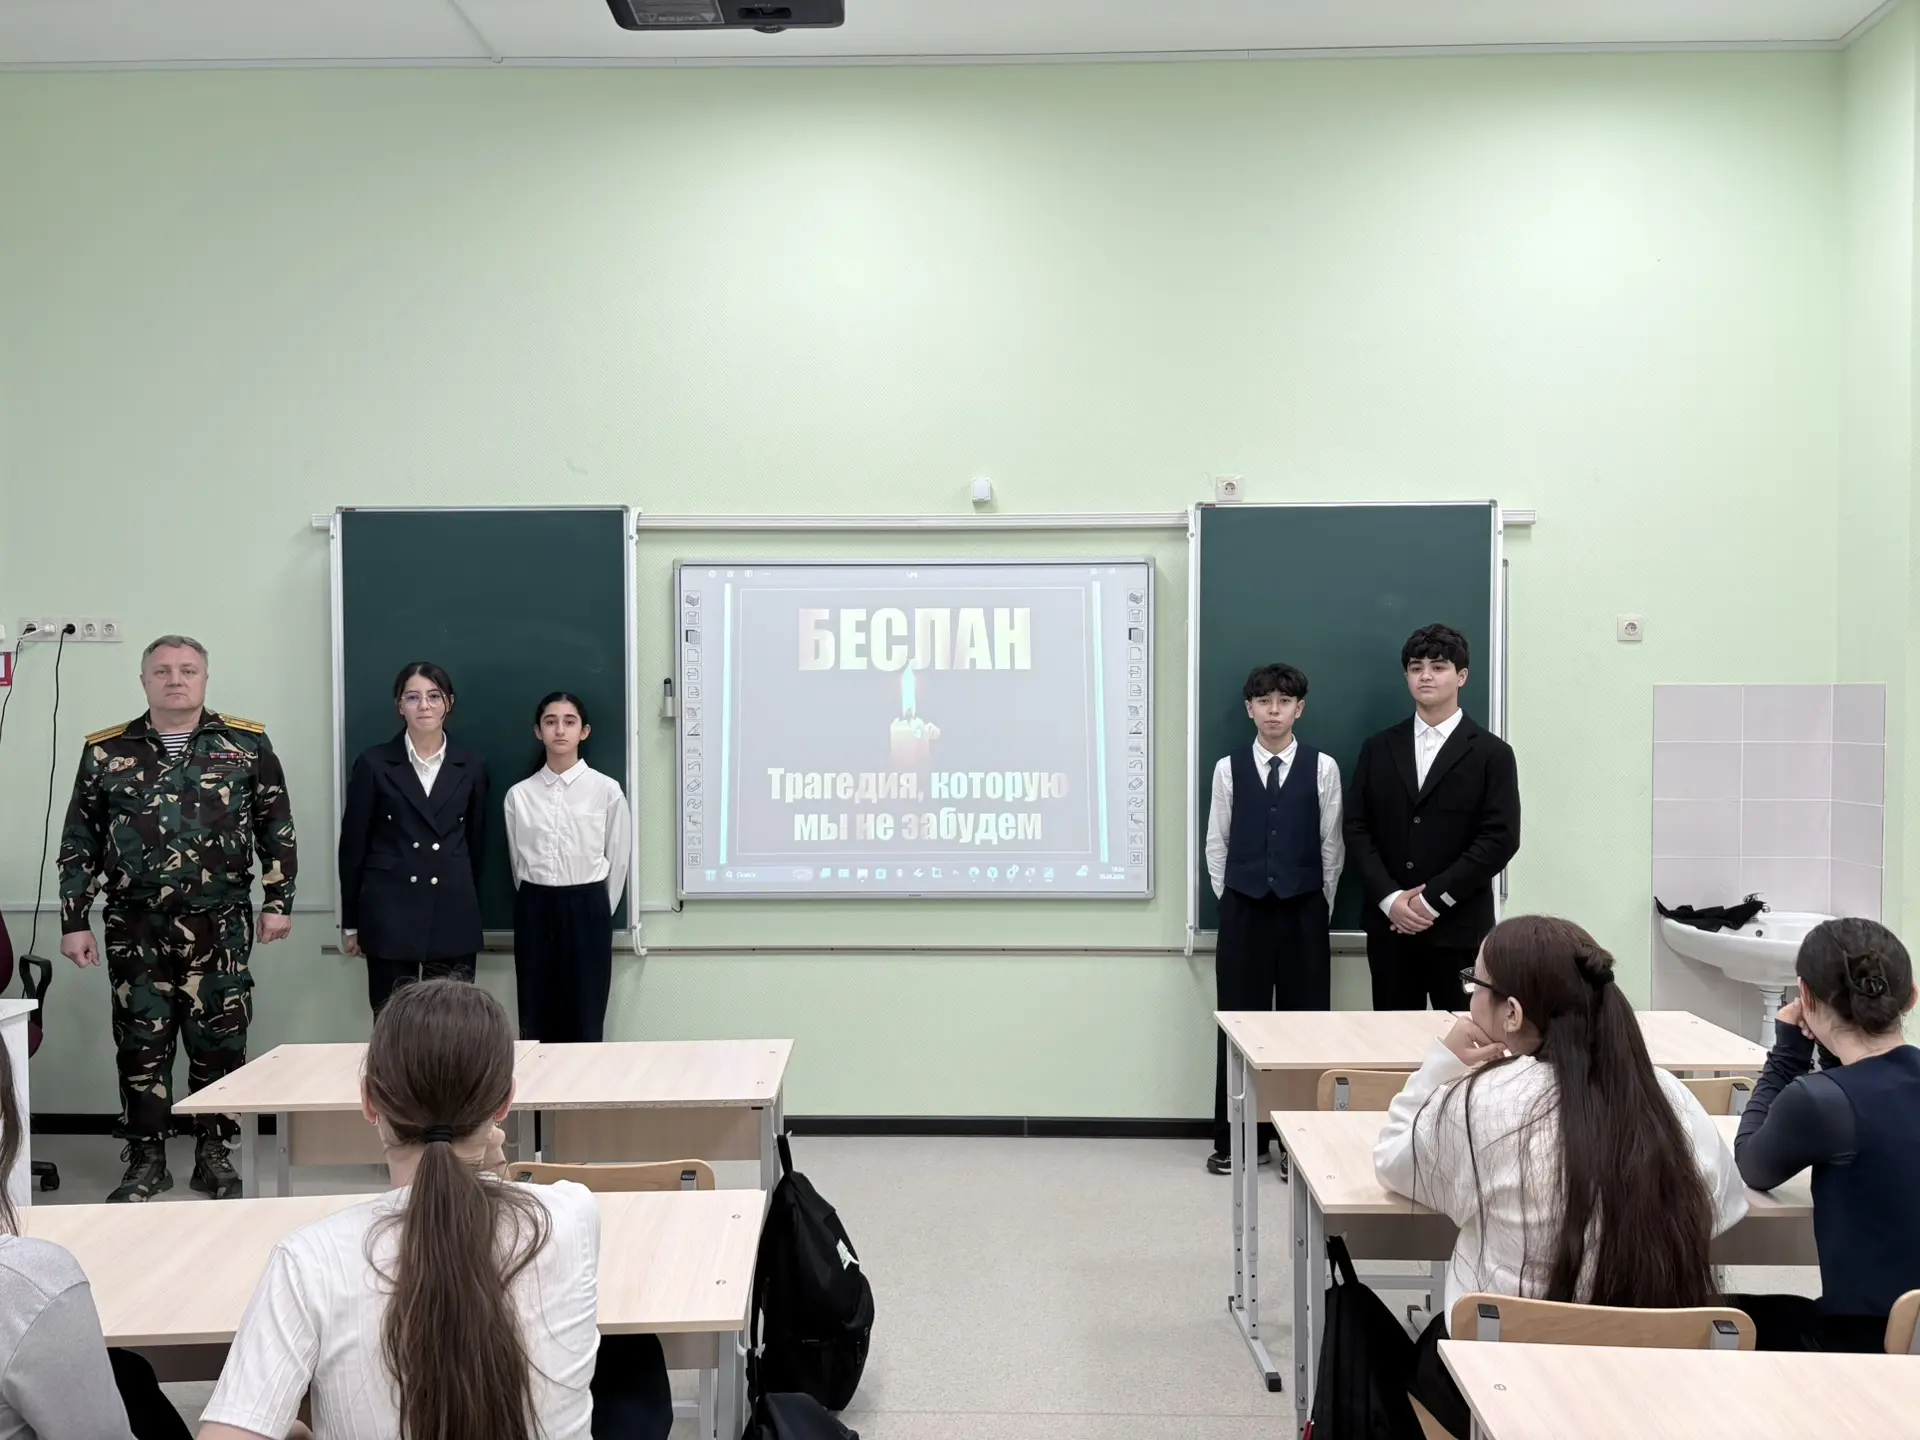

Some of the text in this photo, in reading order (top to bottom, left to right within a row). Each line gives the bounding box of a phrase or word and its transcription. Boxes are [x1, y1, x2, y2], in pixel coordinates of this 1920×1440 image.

[798, 607, 1032, 672] БЕСЛАН
[767, 767, 1069, 804] Трагедия, которую
[794, 806, 1043, 845] мы не забудем
